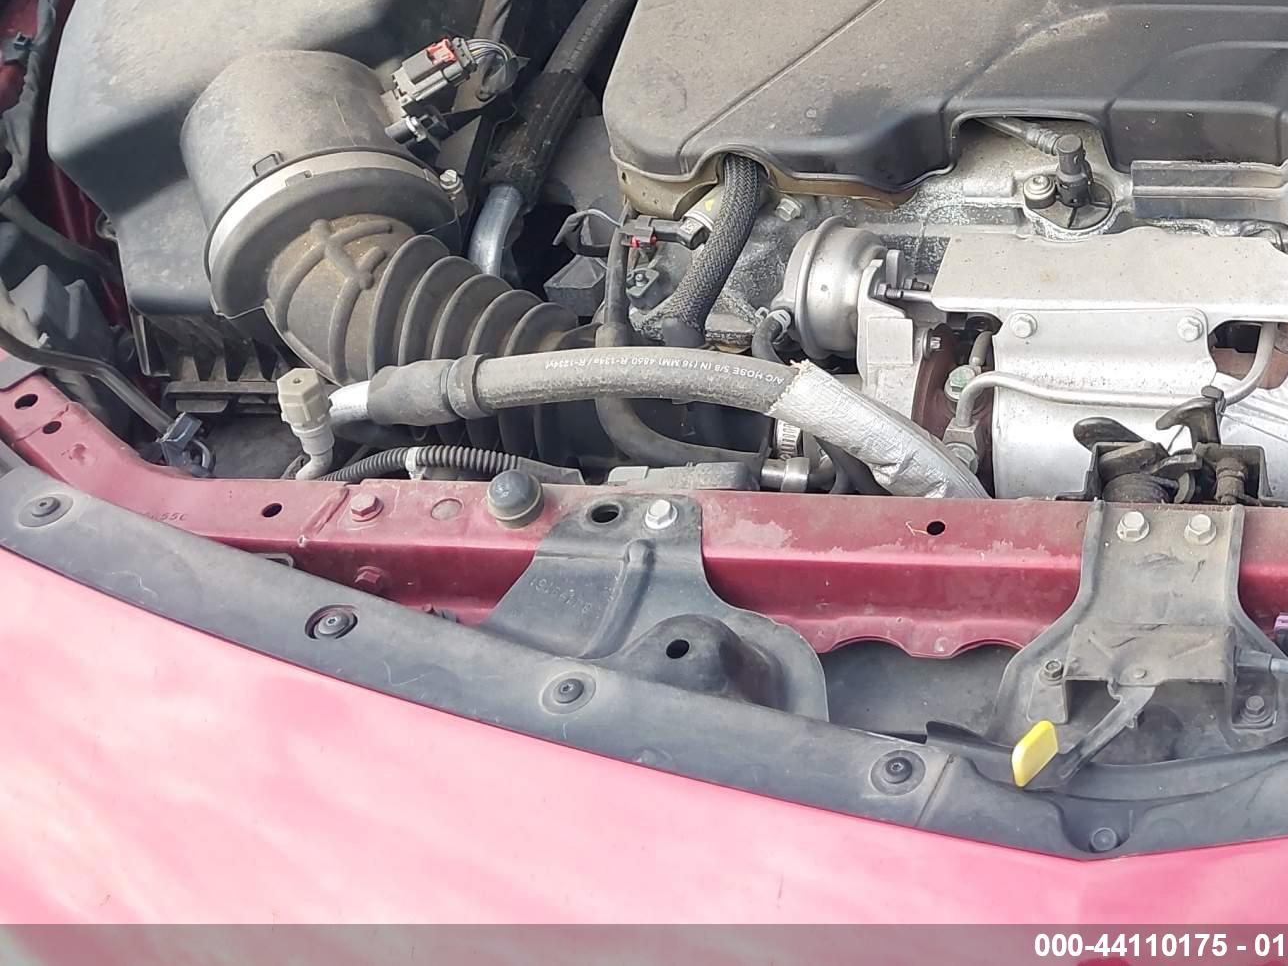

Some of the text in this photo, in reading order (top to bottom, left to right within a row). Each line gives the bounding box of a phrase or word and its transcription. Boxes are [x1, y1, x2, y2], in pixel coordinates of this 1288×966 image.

[699, 361, 712, 371] IN
[714, 363, 730, 373] 5/8
[732, 366, 763, 380] HOSE
[764, 374, 785, 385] A/C
